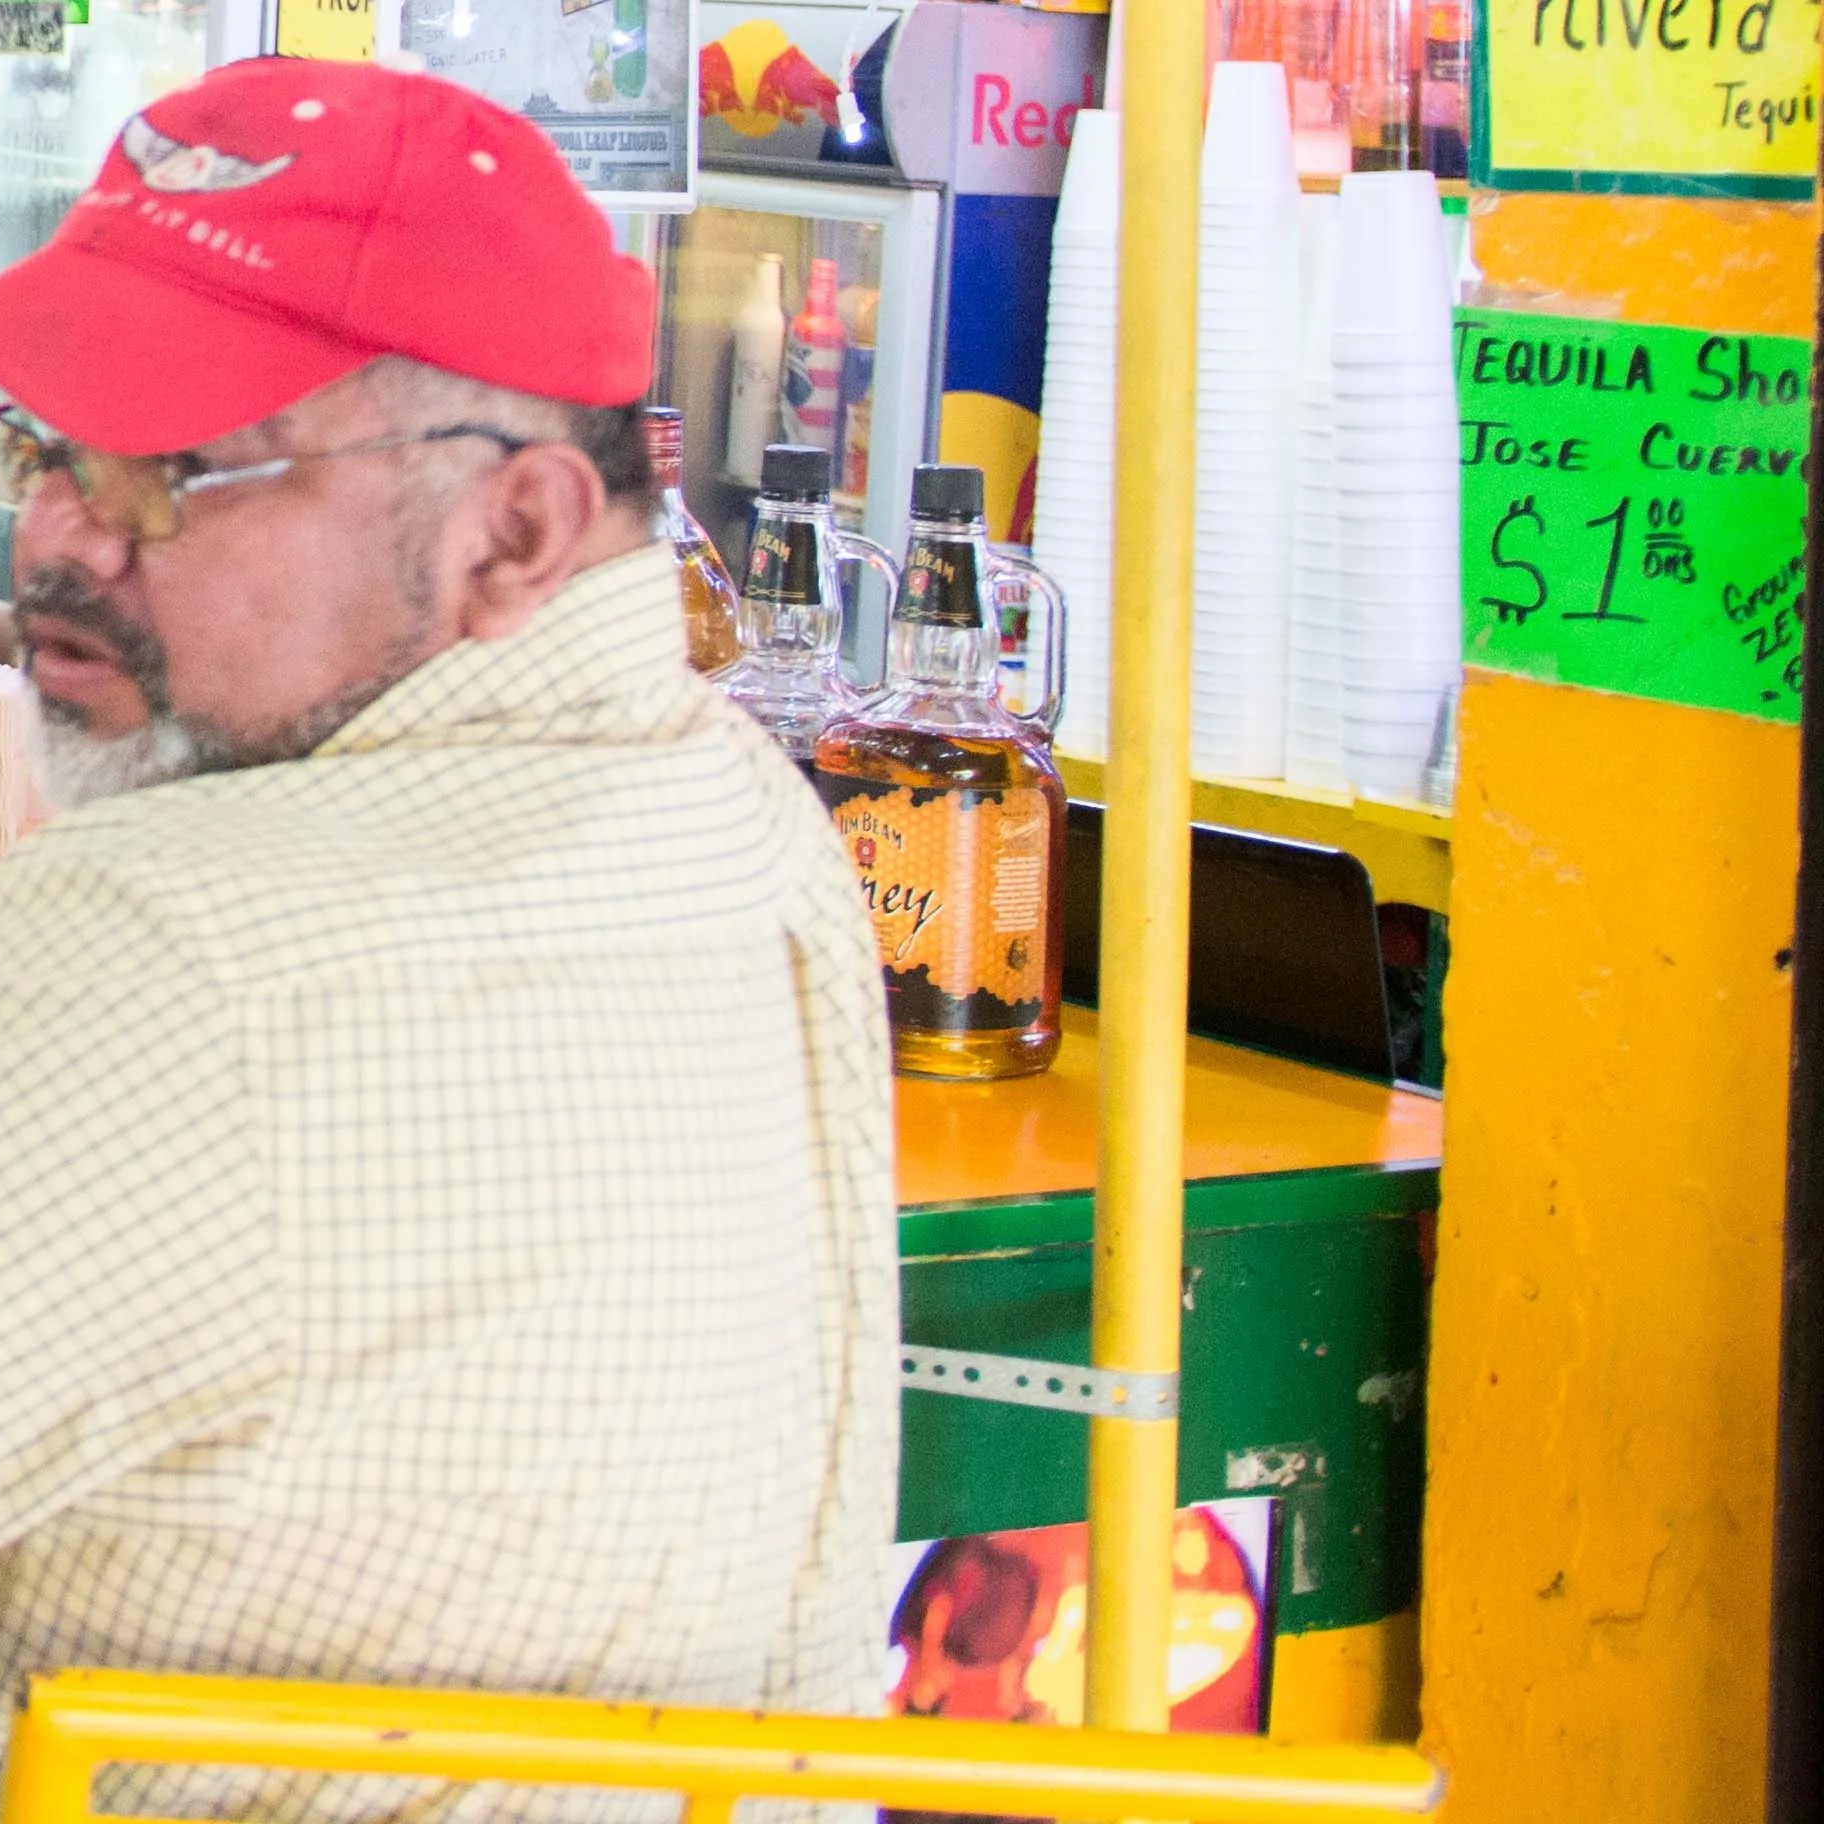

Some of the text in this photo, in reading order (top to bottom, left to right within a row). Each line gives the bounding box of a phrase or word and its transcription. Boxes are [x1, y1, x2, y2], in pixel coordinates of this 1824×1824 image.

[1458, 420, 1591, 473] JOSE
[914, 546, 955, 584] BEAM
[862, 810, 903, 851] BEAM
